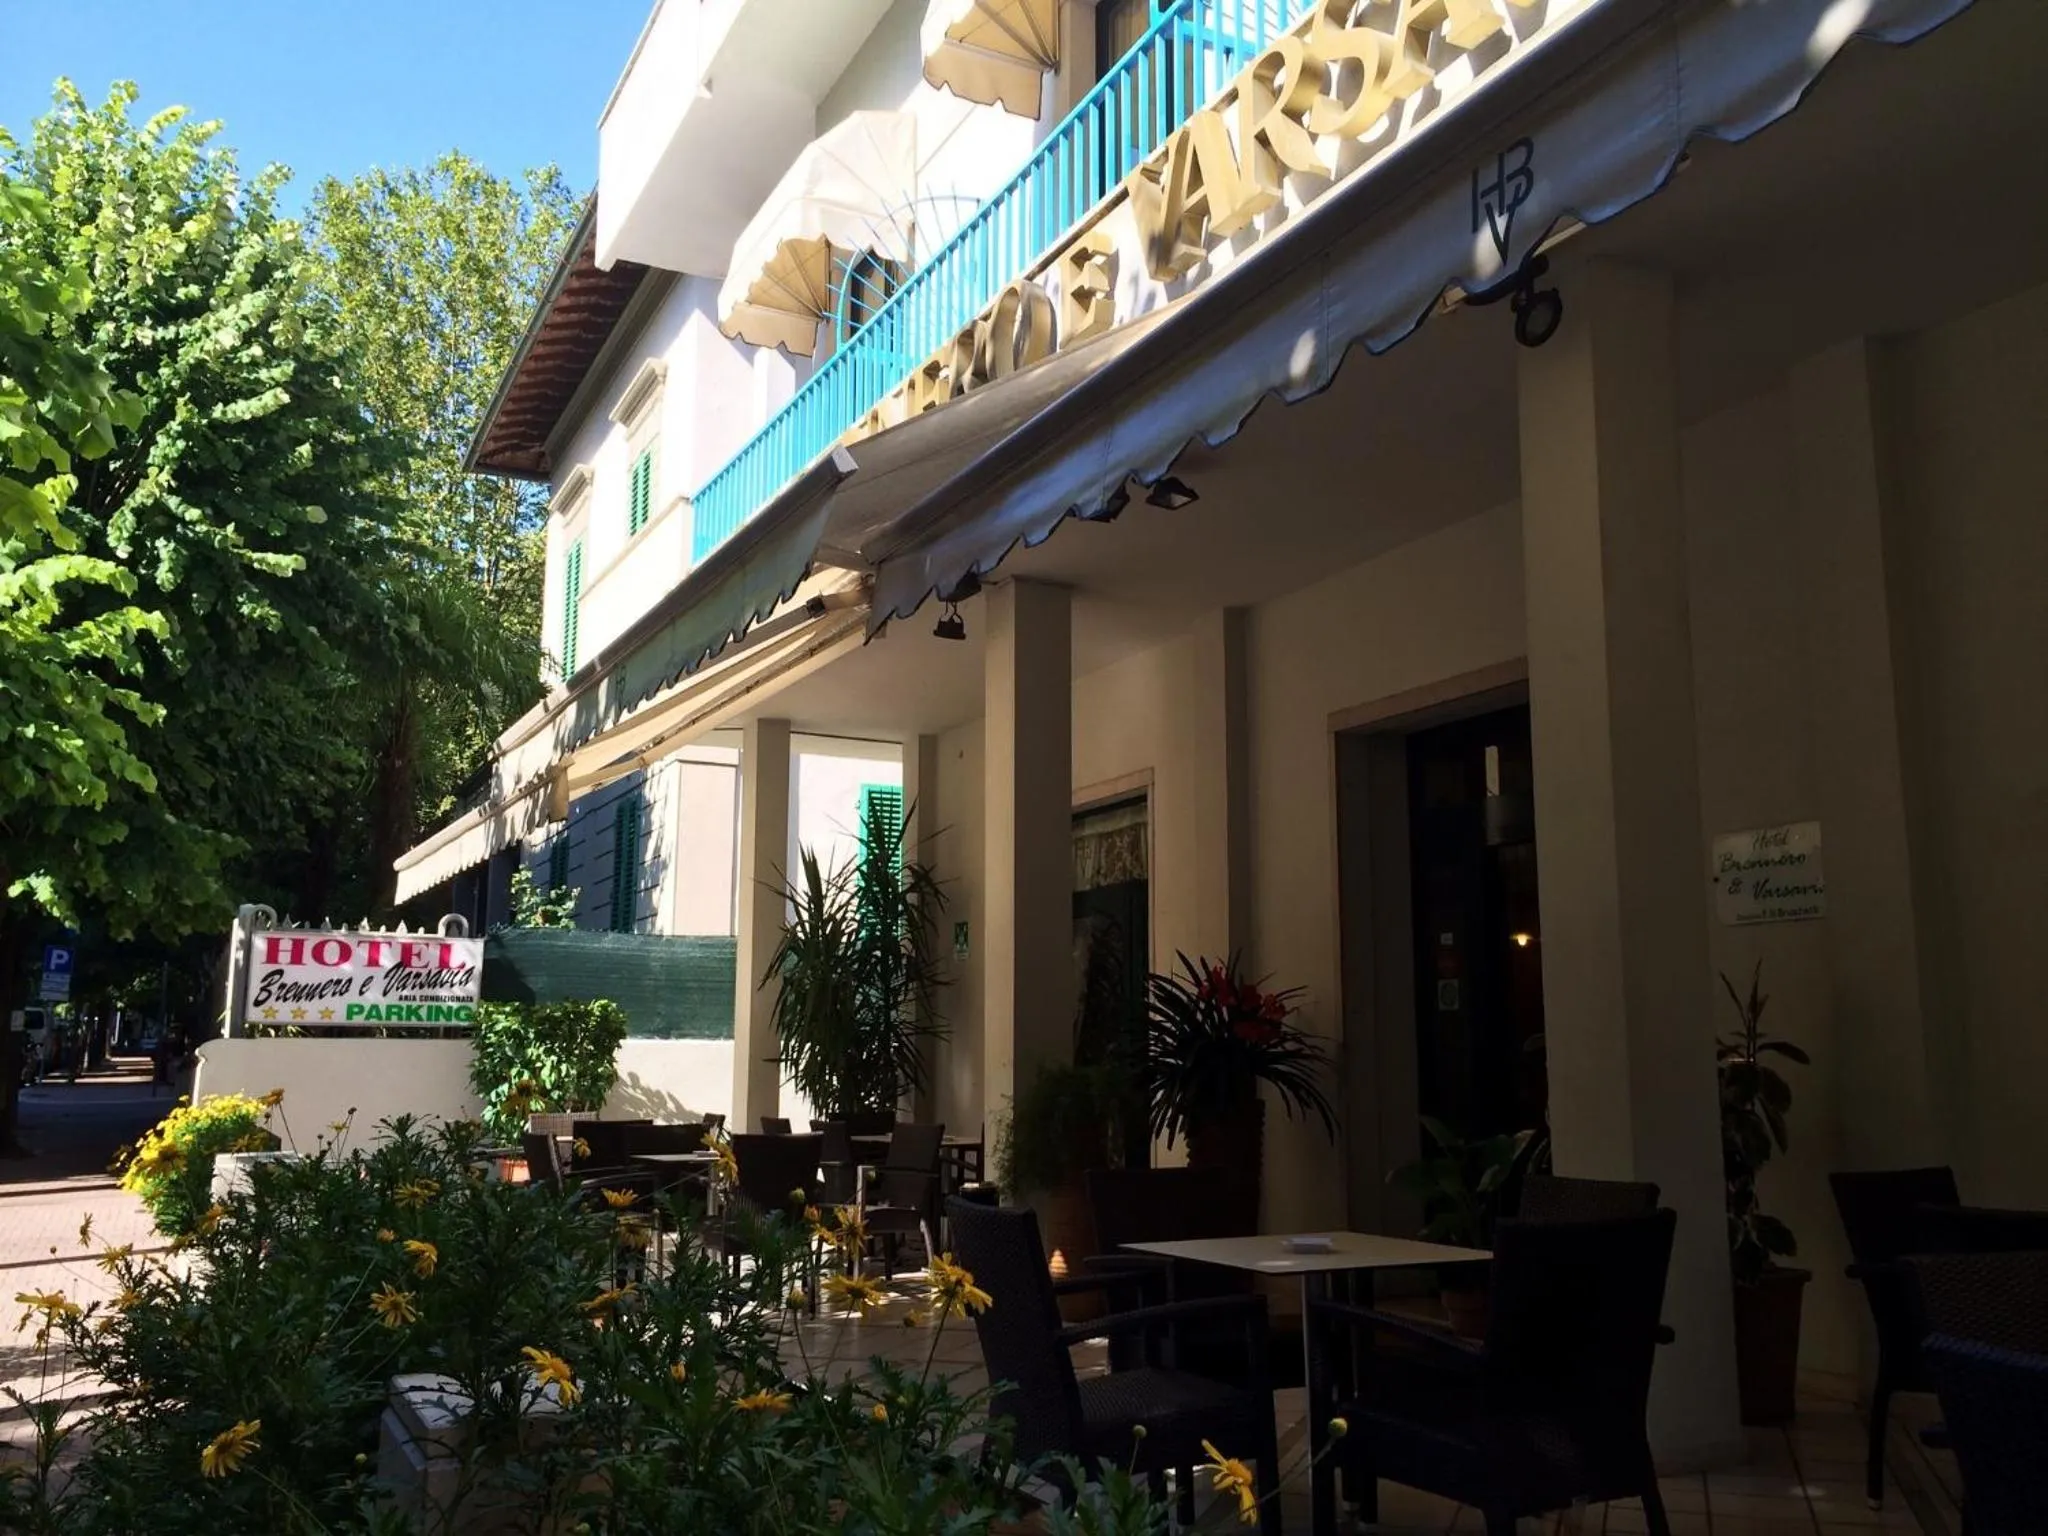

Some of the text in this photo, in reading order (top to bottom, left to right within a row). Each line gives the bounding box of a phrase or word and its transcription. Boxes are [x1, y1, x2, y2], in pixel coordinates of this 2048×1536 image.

[50, 949, 70, 970] P
[262, 936, 467, 971] HOTEL
[253, 961, 476, 1008] Brennero e Varsavia
[346, 1003, 476, 1022] PARKING
